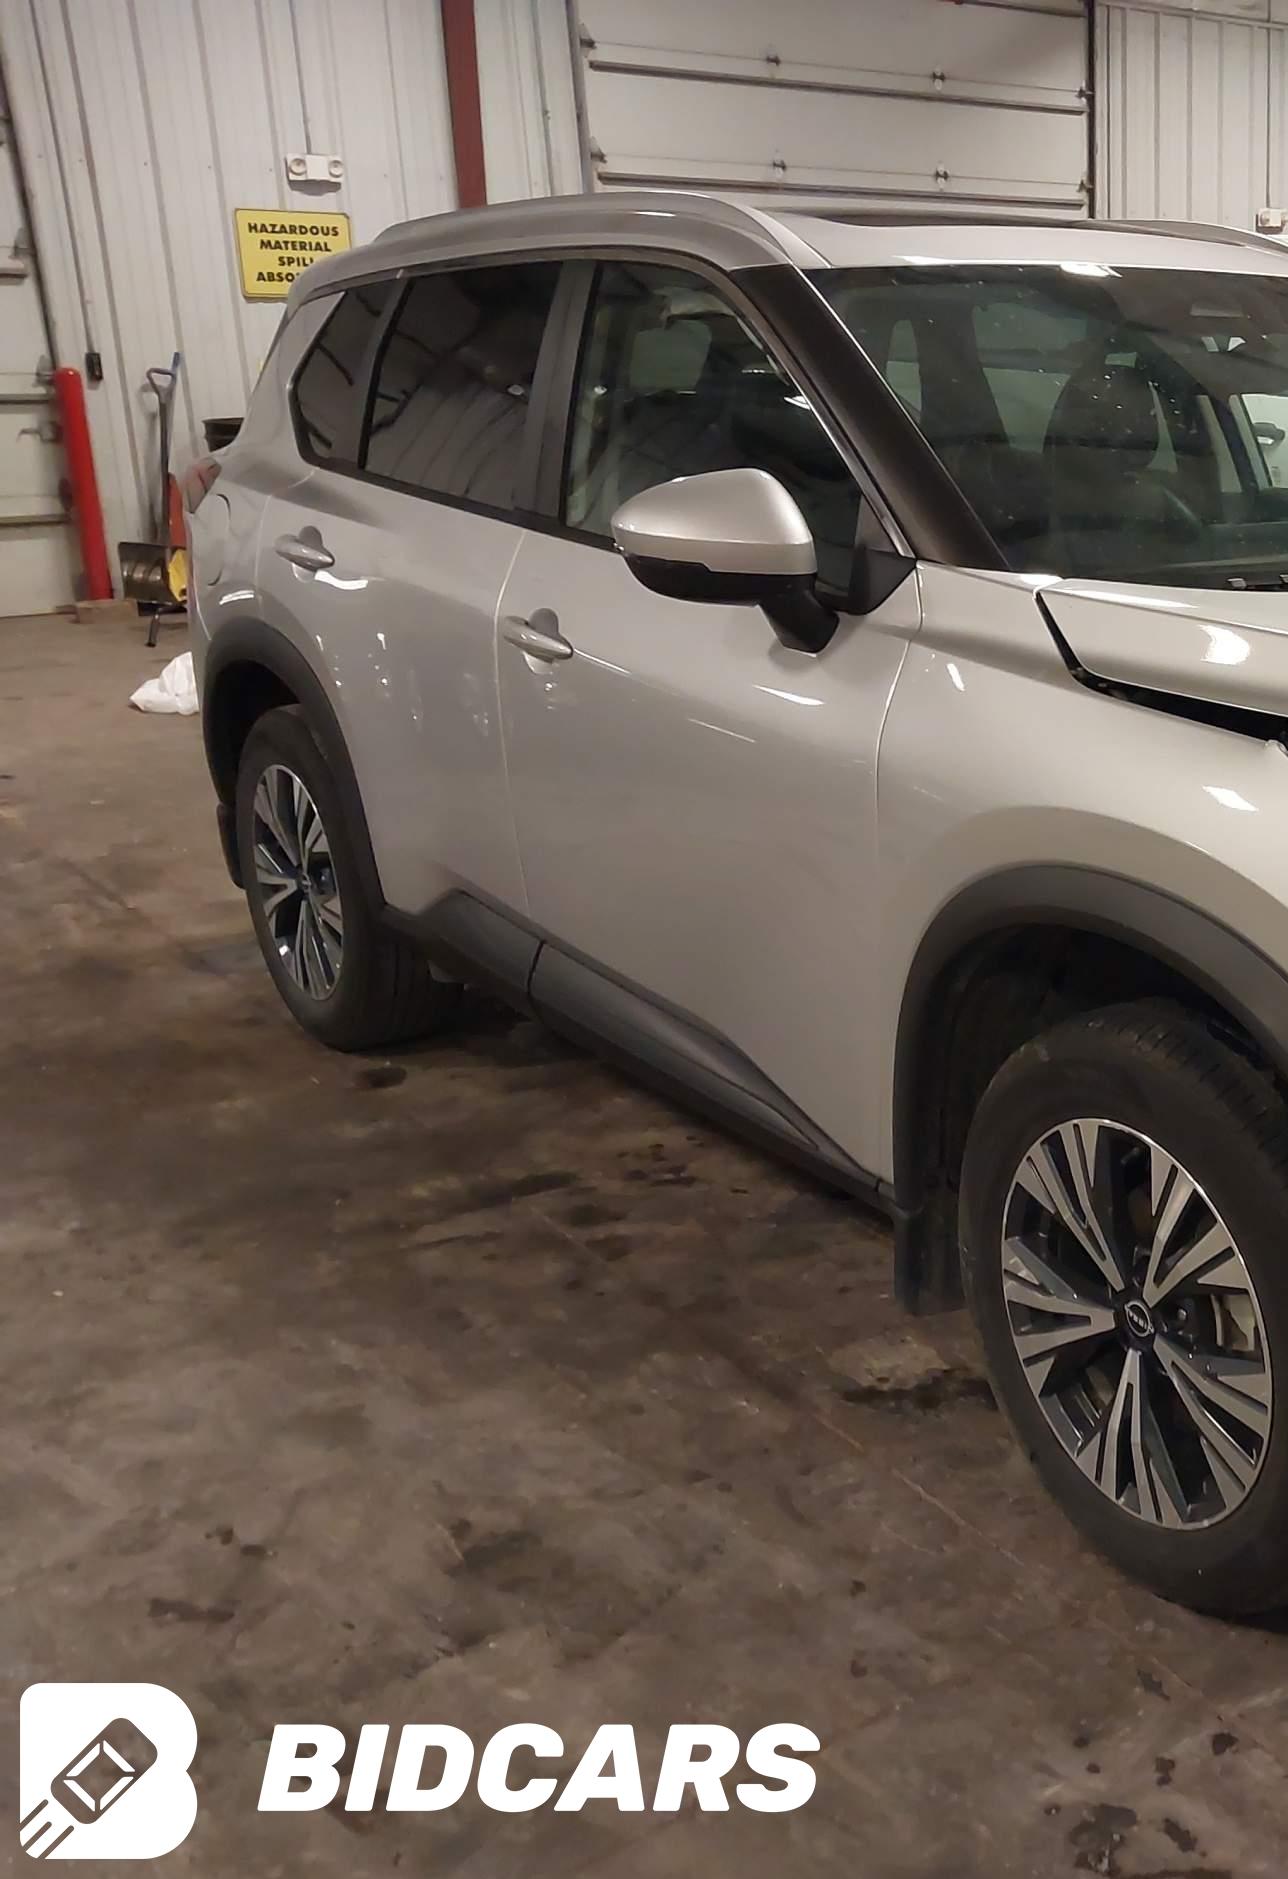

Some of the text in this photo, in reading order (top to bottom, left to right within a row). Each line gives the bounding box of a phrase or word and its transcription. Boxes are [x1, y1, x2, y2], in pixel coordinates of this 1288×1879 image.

[247, 222, 340, 237] HAZARDOUS
[259, 239, 332, 252] MATERIAL
[256, 271, 300, 283] ABSO
